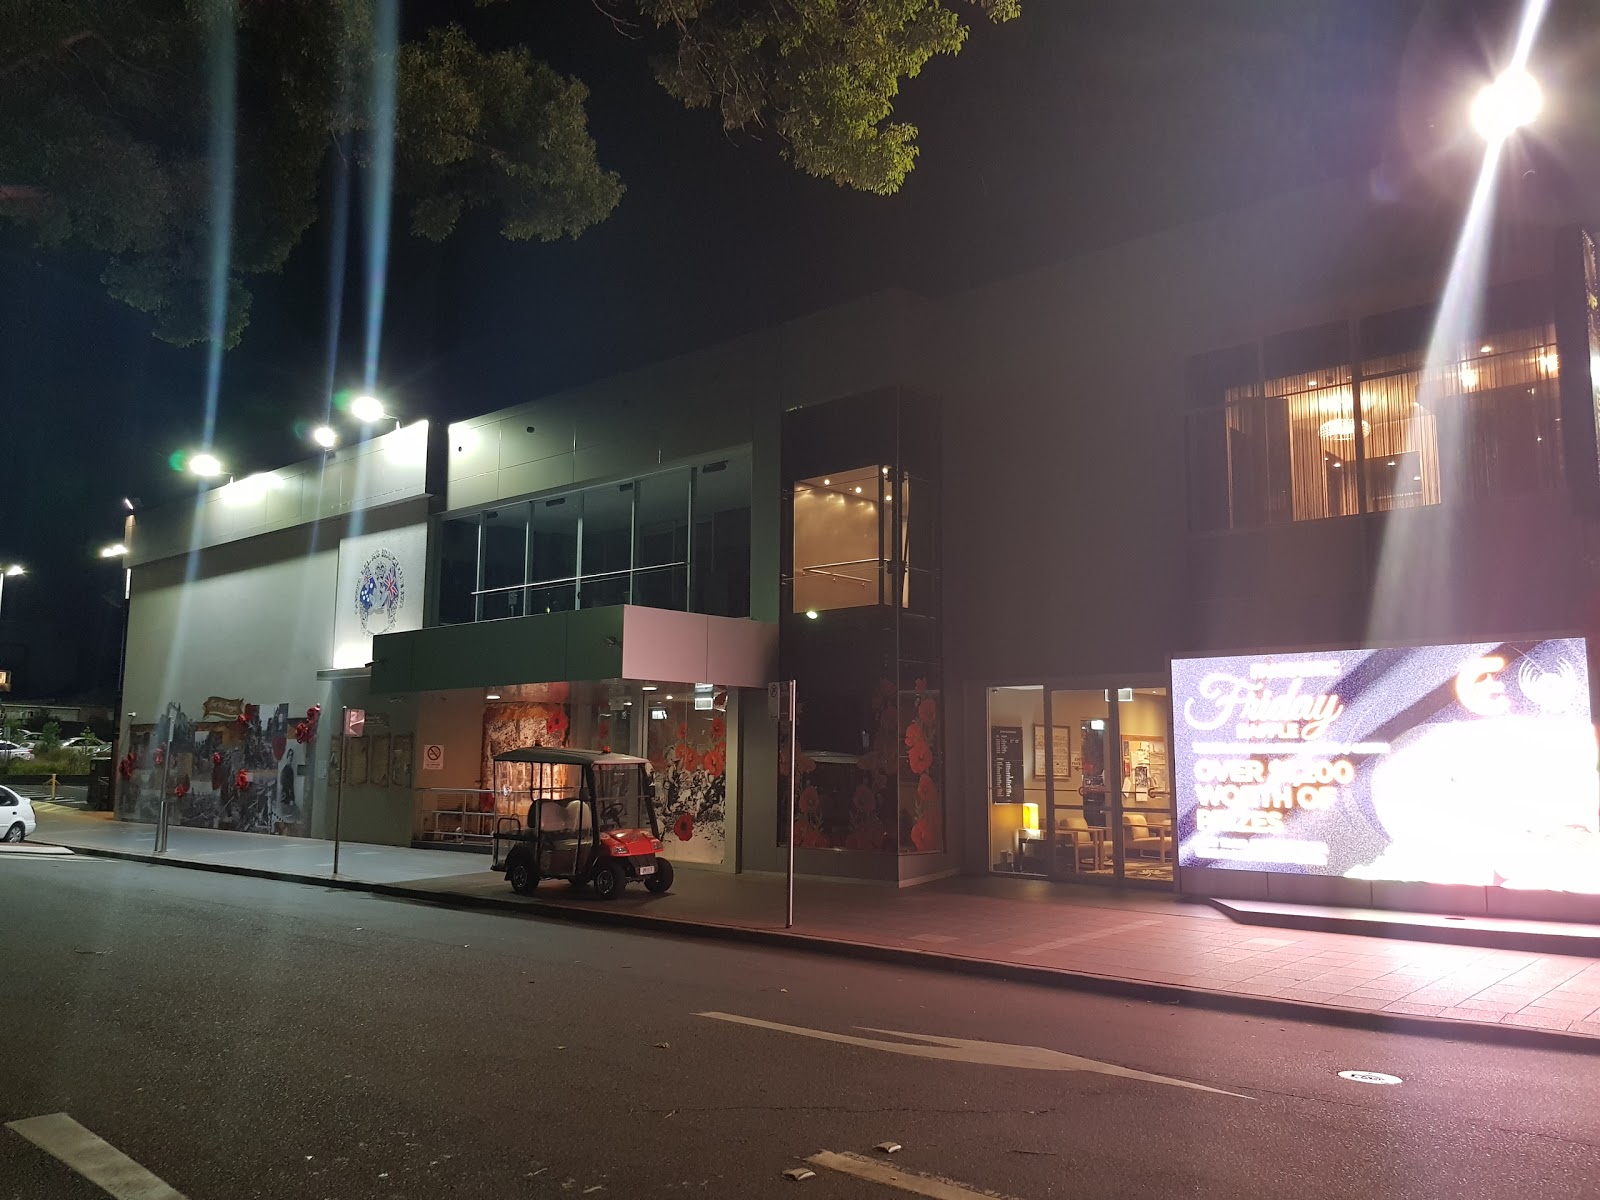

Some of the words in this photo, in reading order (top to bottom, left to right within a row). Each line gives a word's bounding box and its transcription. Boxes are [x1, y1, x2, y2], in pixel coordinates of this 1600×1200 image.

[1184, 673, 1344, 740] Friday
[1194, 760, 1264, 782] OVER
[1297, 786, 1337, 809] OF
[1197, 809, 1284, 833] PZES
